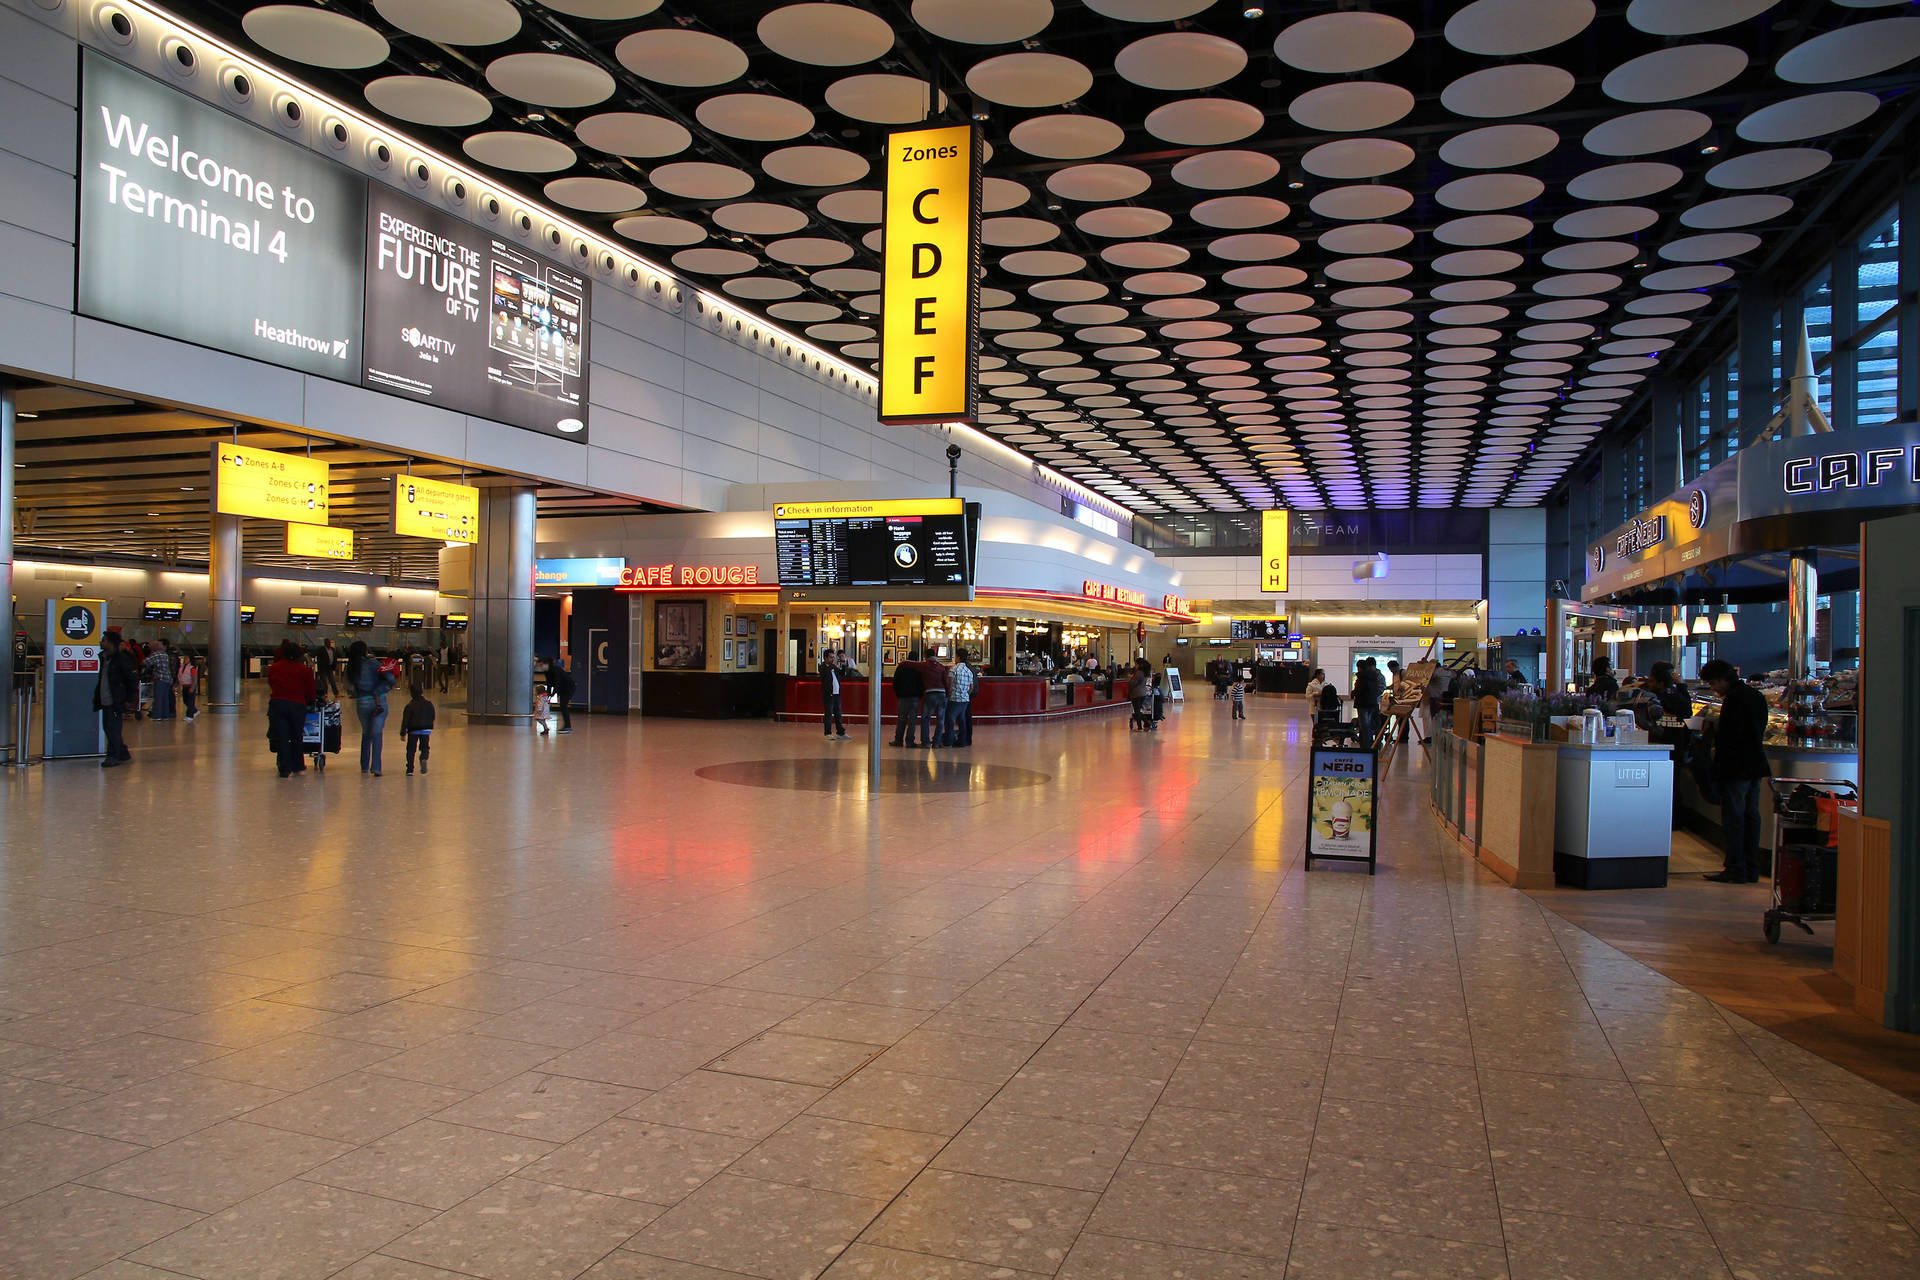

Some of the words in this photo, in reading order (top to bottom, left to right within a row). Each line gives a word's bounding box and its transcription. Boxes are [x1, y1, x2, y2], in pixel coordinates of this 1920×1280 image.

[902, 145, 958, 163] Zones
[101, 105, 275, 210] Welcome
[281, 186, 315, 223] to
[99, 162, 260, 255] Terminal
[267, 230, 288, 264] 4
[912, 188, 940, 224] C
[379, 211, 457, 260] EXPERIENCE
[458, 245, 481, 270] THE
[911, 242, 942, 279] D
[378, 232, 481, 306] FUTURE
[446, 296, 462, 316] OF
[463, 302, 480, 323] TV
[914, 297, 937, 335] E
[254, 318, 331, 355] Heathrow
[418, 351, 432, 361] Join
[443, 340, 456, 356] TV
[913, 356, 935, 394] F
[245, 457, 269, 469] Zones
[271, 462, 285, 471] A-B
[1784, 446, 1920, 494] CAF
[269, 477, 292, 488] Zones
[293, 481, 306, 490] C-F
[266, 493, 290, 504] Zones
[291, 497, 306, 506] G-H
[416, 486, 424, 494] All
[425, 488, 454, 499] departure
[455, 494, 471, 502] gates
[787, 506, 823, 514] Check-in
[824, 505, 874, 513] information
[1292, 525, 1359, 535] KYTEAM
[1269, 559, 1280, 570] G
[620, 563, 674, 585] CAFÉ
[681, 564, 758, 585] ROUGE
[1270, 575, 1279, 586] H
[1424, 617, 1431, 626] H
[1405, 669, 1432, 679] PANINI
[1323, 762, 1363, 772] NERO
[1618, 768, 1647, 780] LITTER
[1315, 788, 1369, 798] LEMONADE
